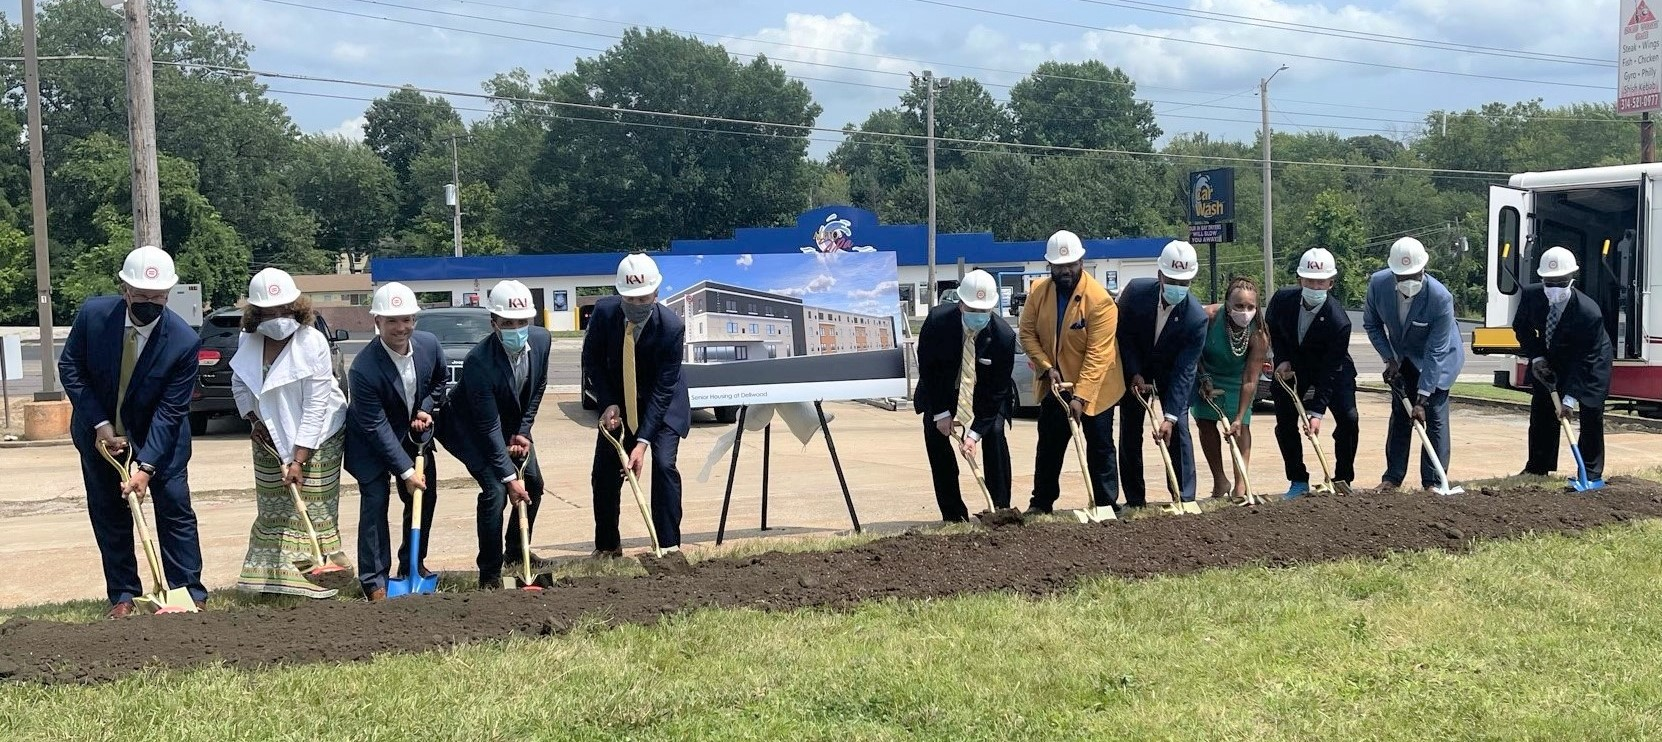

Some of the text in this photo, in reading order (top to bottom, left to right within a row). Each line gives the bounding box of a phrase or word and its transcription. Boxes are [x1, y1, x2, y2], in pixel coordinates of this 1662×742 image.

[1622, 41, 1660, 53] Steak Wings
[1622, 54, 1660, 67] Fish Chicken
[1624, 67, 1657, 81] Gyro Philly
[1195, 201, 1224, 217] Wash
[1172, 260, 1188, 270] KAI
[1307, 261, 1323, 270] KAI
[626, 274, 644, 285] KAI
[508, 298, 527, 308] KAI
